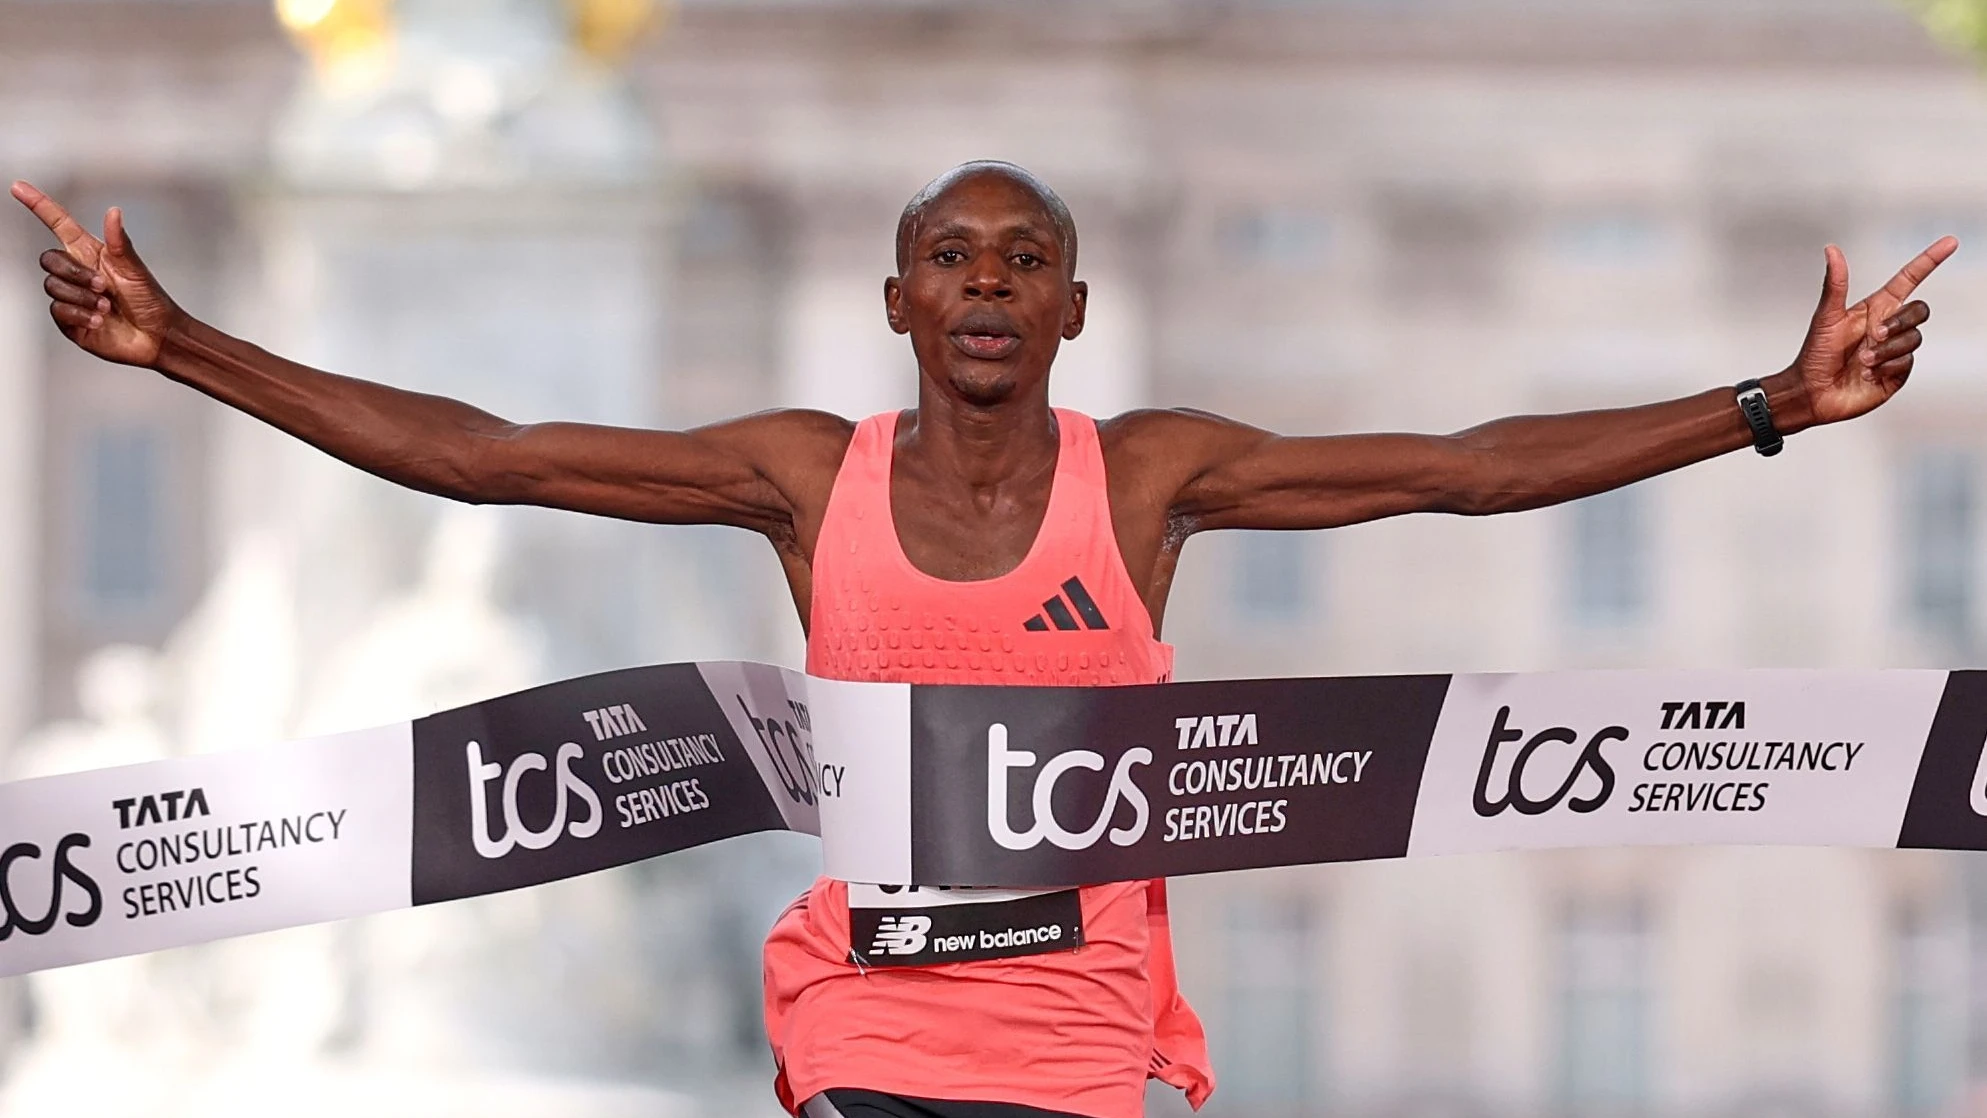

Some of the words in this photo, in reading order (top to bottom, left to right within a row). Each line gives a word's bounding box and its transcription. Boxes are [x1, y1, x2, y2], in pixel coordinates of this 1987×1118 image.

[583, 703, 647, 742] TATA
[1174, 713, 1259, 750] TATA
[1660, 701, 1746, 730] TATA
[602, 733, 726, 784] CONSULTANCY
[1168, 750, 1372, 796] CONSULTANCY
[1472, 705, 1629, 817] tcs
[1643, 741, 1865, 772] CONSULTANCY
[112, 788, 211, 829] TATA
[466, 740, 603, 858] tcs
[615, 778, 710, 829] SERVICES
[988, 723, 1153, 851] tcs
[1627, 782, 1769, 813] SERVICES
[117, 809, 347, 874] CONSULTANCY
[1163, 800, 1288, 842] SERVICES
[0, 832, 103, 942] cs
[123, 867, 261, 919] SERVICES
[933, 933, 976, 953] new
[980, 924, 1062, 949] balance
